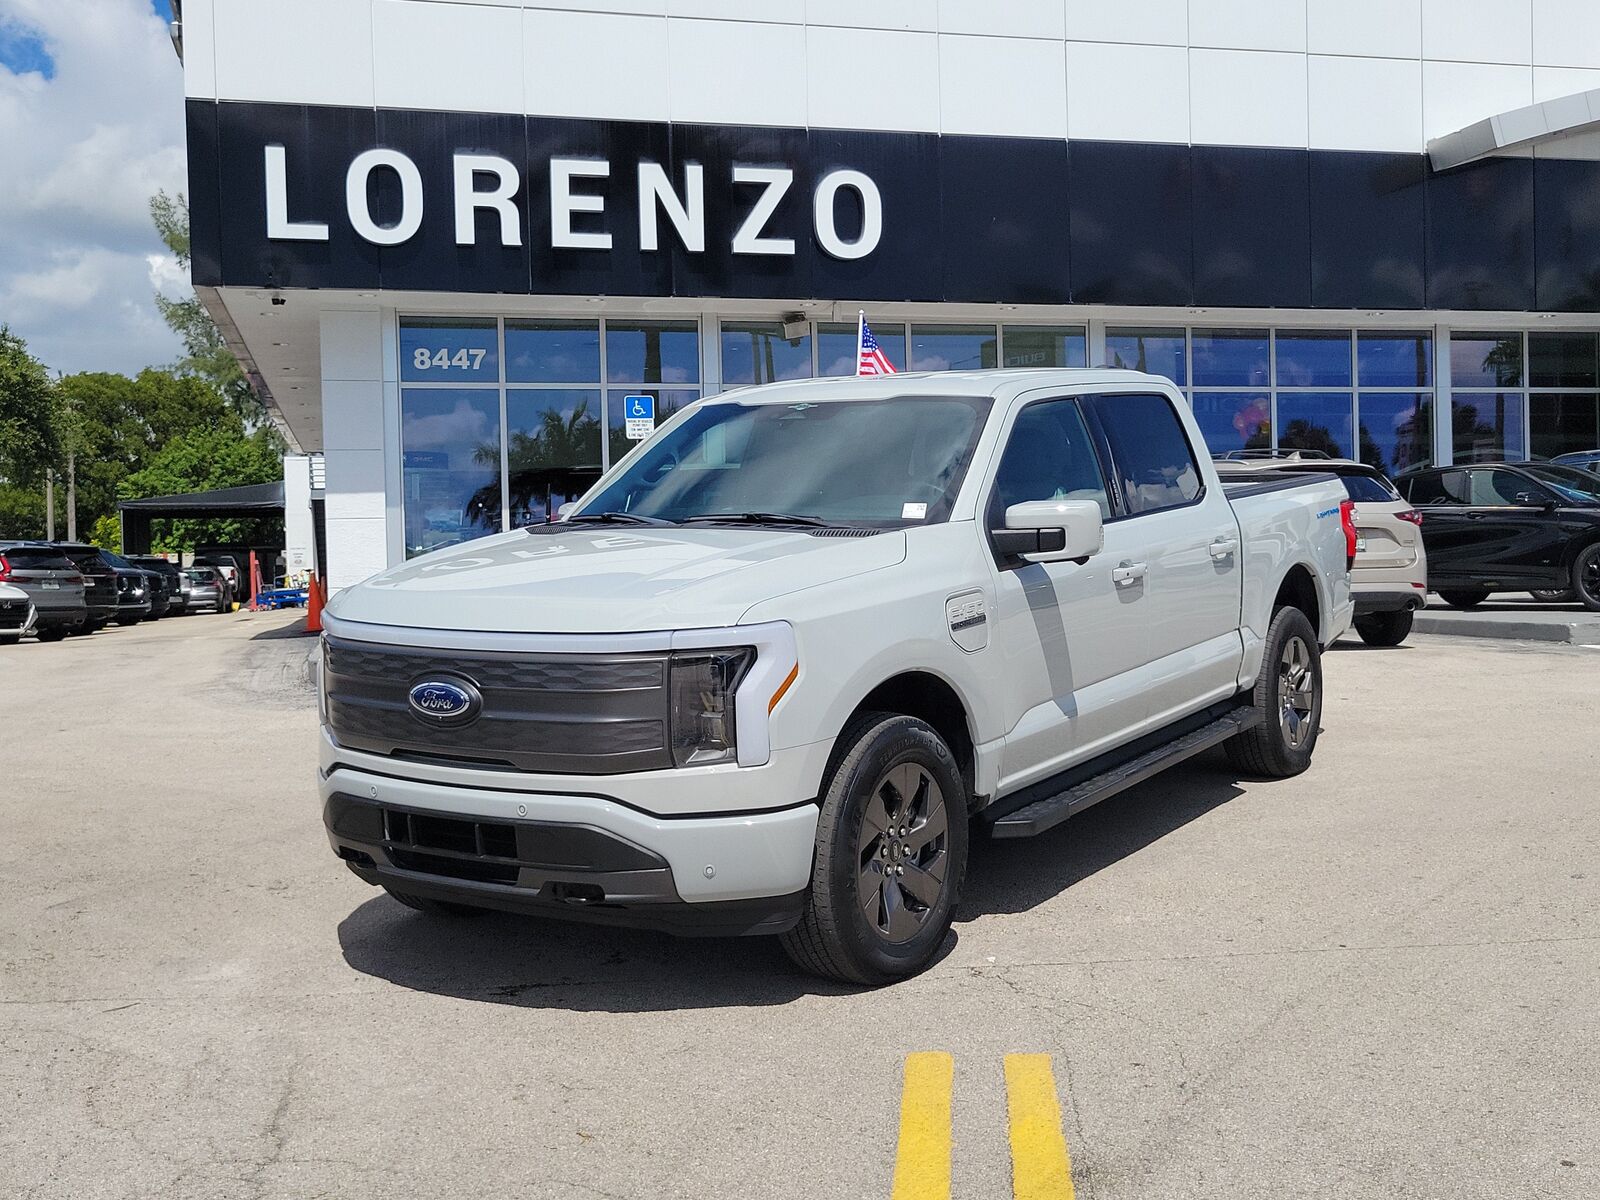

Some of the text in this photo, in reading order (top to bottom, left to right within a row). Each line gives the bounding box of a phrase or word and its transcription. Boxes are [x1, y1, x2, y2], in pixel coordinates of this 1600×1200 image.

[265, 143, 883, 260] LORENZO
[413, 347, 487, 370] 8447
[421, 689, 453, 709] Ford
